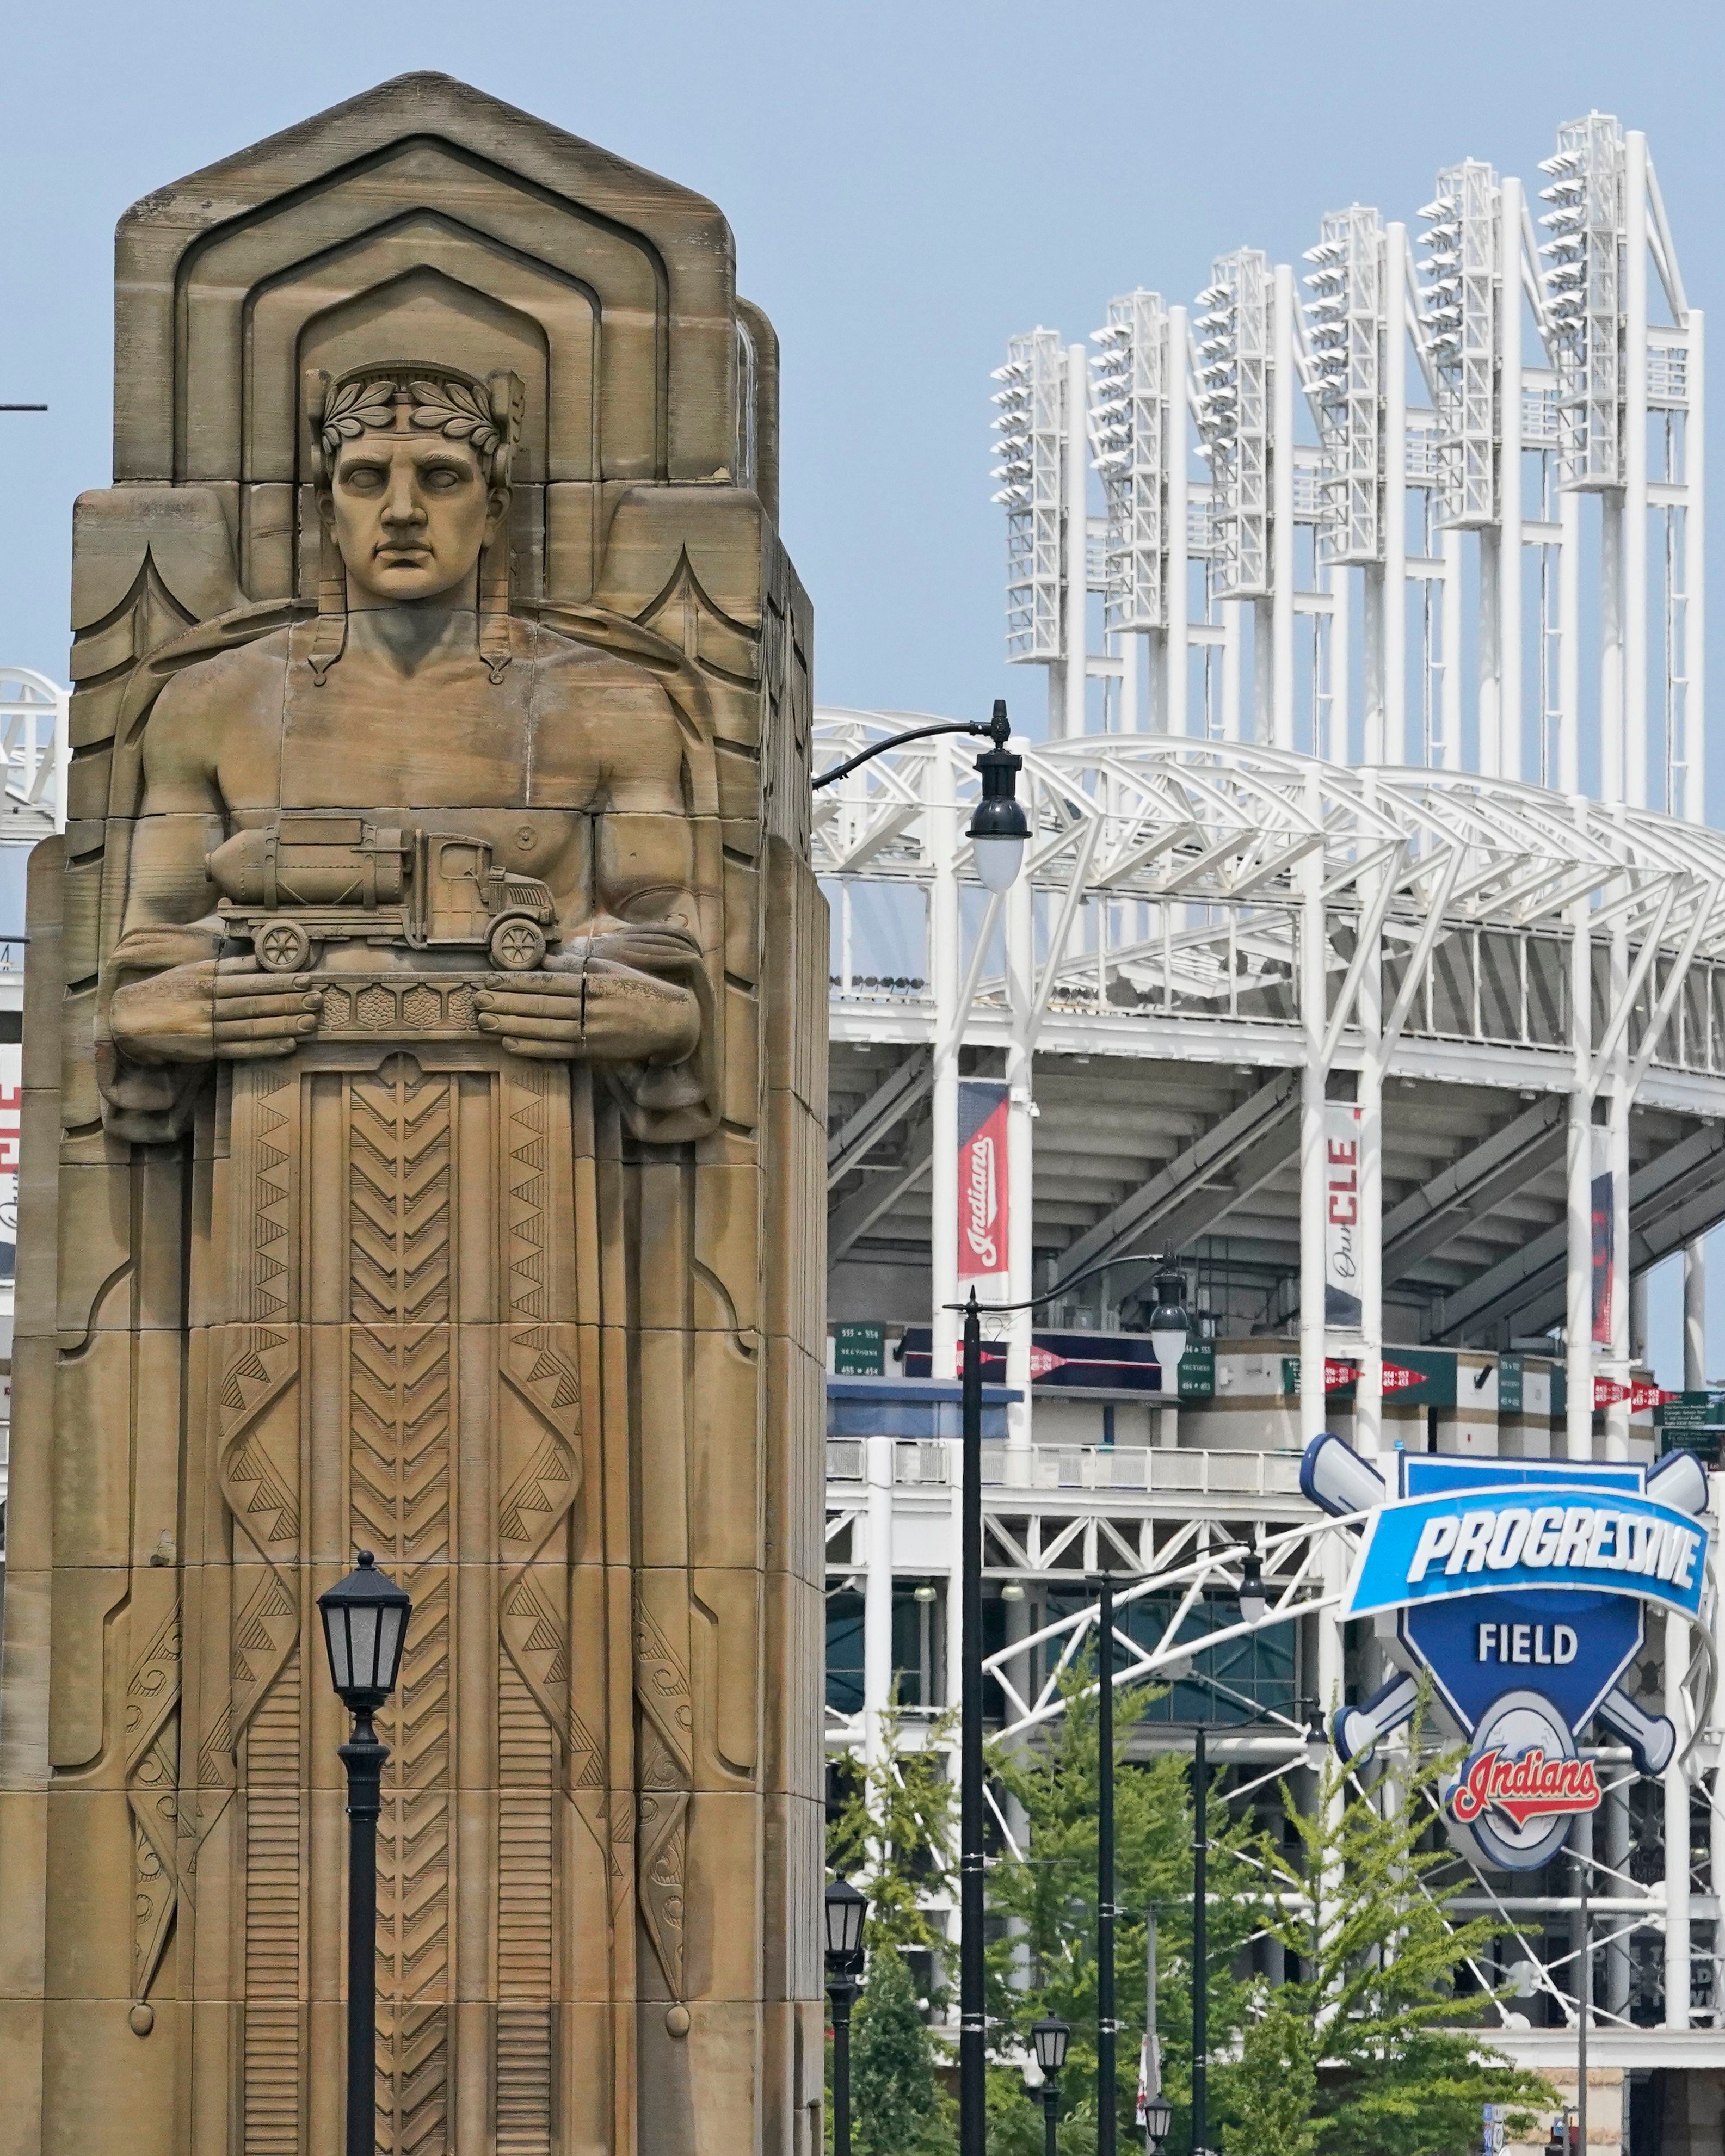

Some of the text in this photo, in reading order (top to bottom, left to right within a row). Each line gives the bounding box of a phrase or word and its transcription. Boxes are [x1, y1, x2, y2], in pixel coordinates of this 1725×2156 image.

[967, 1136, 998, 1267] Indians
[1328, 1139, 1357, 1225] CLE
[1407, 1506, 1701, 1590] PROGRESSIVE
[1479, 1623, 1578, 1664] FIELD
[1452, 1745, 1602, 1828] Indians
